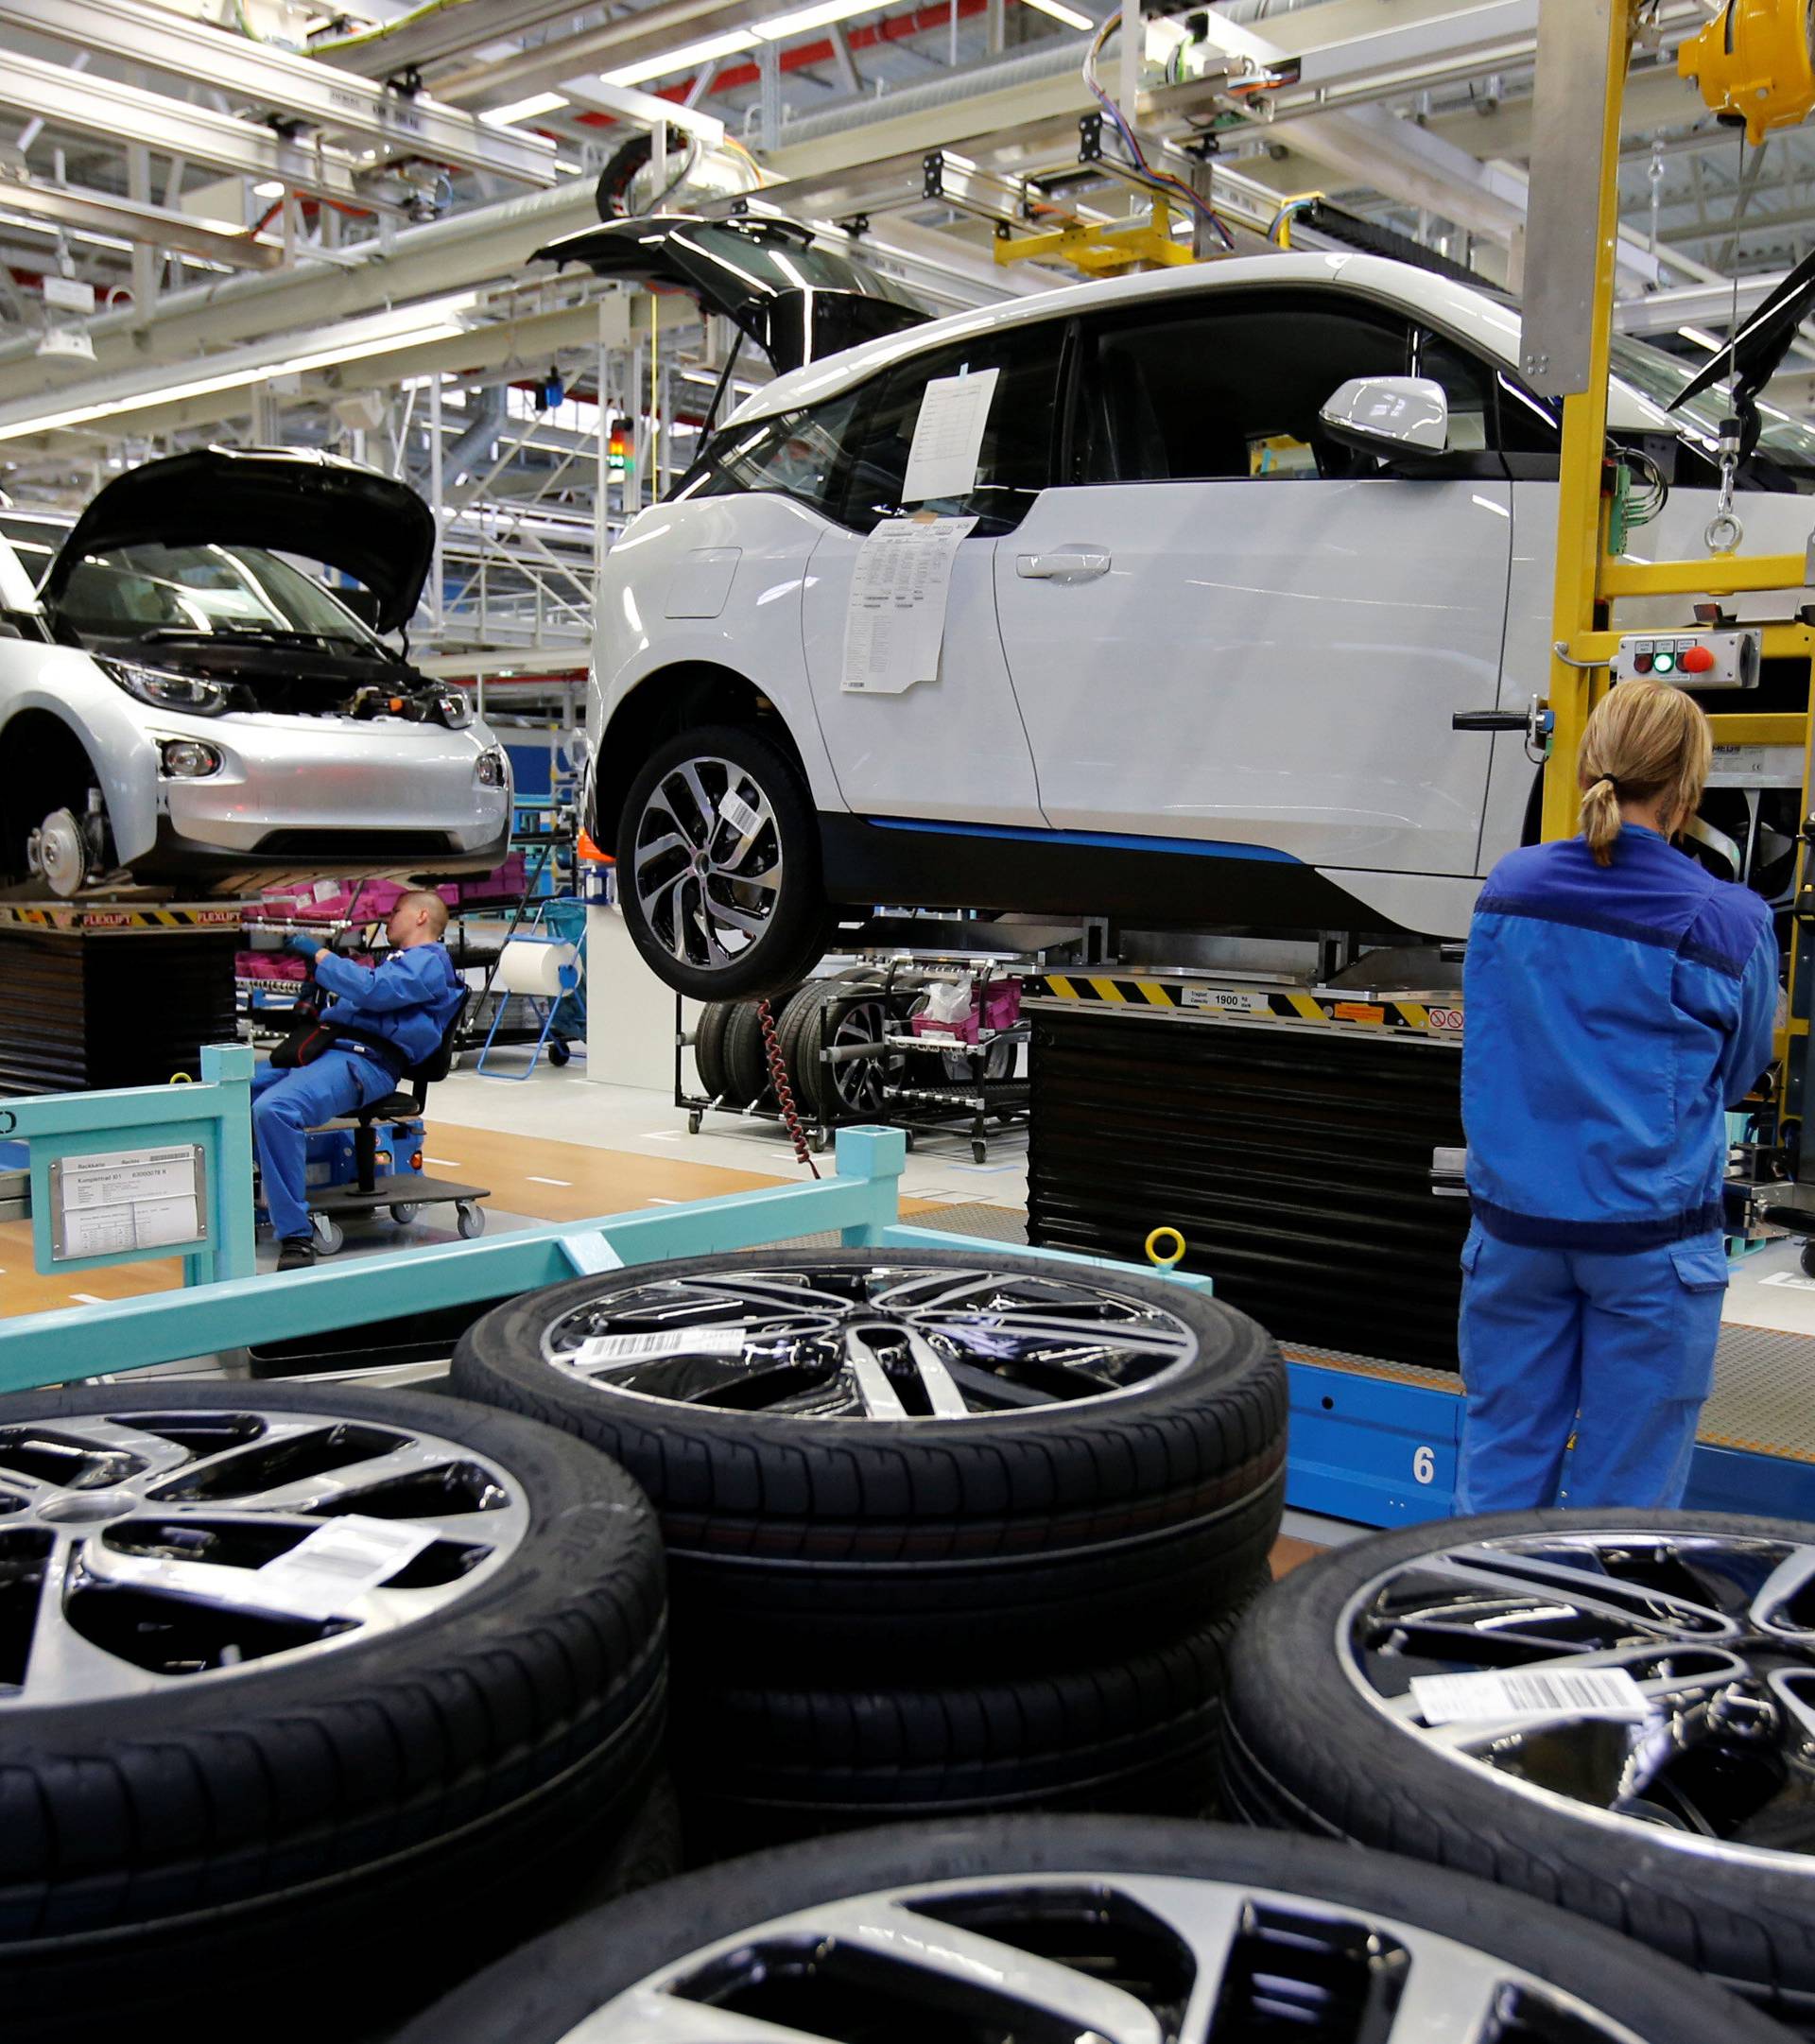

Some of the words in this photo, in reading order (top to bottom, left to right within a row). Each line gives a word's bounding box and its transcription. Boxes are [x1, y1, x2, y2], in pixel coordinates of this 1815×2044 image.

[83, 914, 131, 926] FLEXLIFT
[198, 911, 241, 922] FLEXLIFT
[1216, 996, 1238, 1005] 1900
[1413, 1446, 1435, 1484] 6
